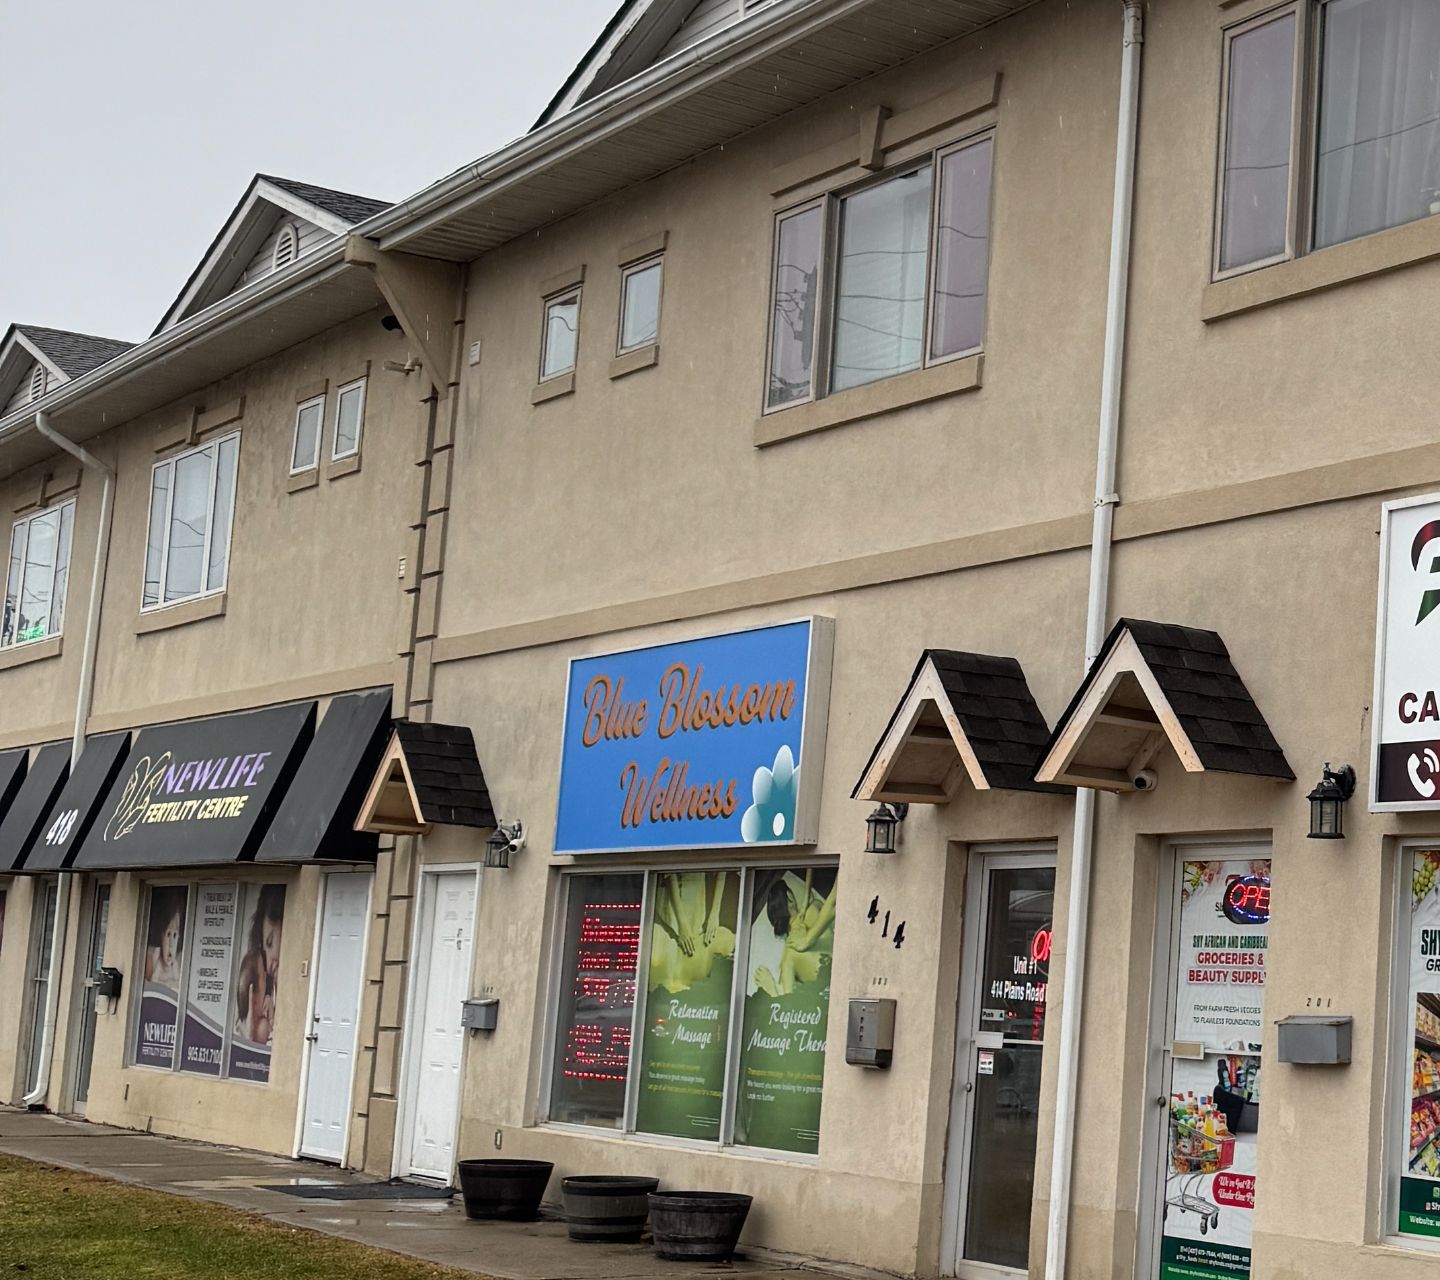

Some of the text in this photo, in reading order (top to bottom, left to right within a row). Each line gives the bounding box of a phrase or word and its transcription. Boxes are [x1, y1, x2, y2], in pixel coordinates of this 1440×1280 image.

[582, 661, 798, 748] Blue Blossom
[156, 752, 272, 796] NEWLIFE
[620, 757, 740, 830] Wellness
[142, 795, 249, 824] FERTILITY CENTRE
[45, 809, 79, 846] 418
[1230, 884, 1271, 906] OPE
[867, 895, 906, 949] 414
[1204, 935, 1227, 949] AFRICAN
[1228, 935, 1239, 949] AND
[1014, 956, 1038, 975] Unit #1
[1198, 951, 1264, 965] GROCERIES &
[1189, 969, 1267, 984] BEAUTY SUPPL
[991, 979, 1003, 999] 414
[1004, 980, 1024, 1001] Plains
[1025, 981, 1044, 1003] Road
[1306, 997, 1331, 1008] 201
[668, 999, 719, 1020] Relaxation
[769, 1003, 822, 1030] Registered
[1194, 1004, 1208, 1012] FROM
[1241, 1006, 1261, 1014] VEGGIES
[1225, 1018, 1261, 1026] FOUNDATIONS
[672, 1024, 712, 1049] Massage
[747, 1029, 790, 1056] Massage
[1409, 1214, 1435, 1227] Website:
